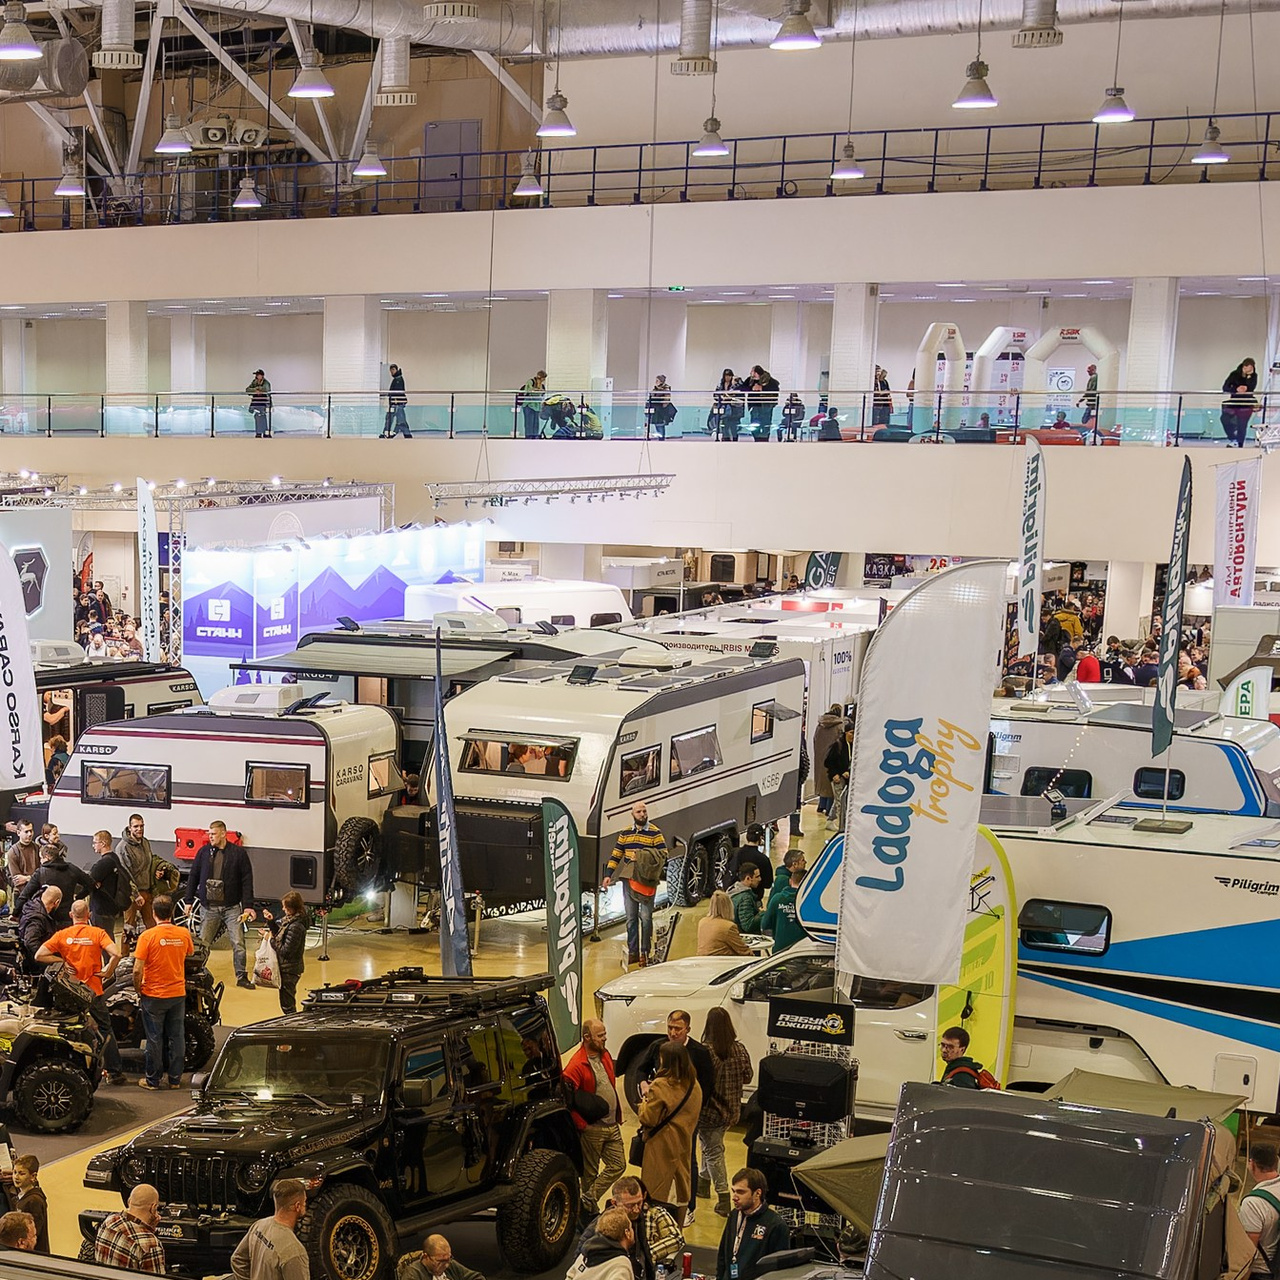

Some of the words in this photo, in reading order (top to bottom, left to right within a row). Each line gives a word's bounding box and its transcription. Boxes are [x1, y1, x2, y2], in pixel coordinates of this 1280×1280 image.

[834, 650, 852, 665] 100%
[78, 744, 114, 755] KARSO
[336, 764, 364, 779] KARSO
[336, 774, 363, 787] CARAVANS
[855, 718, 935, 893] Ladoga
[1231, 878, 1280, 892] Piligrim
